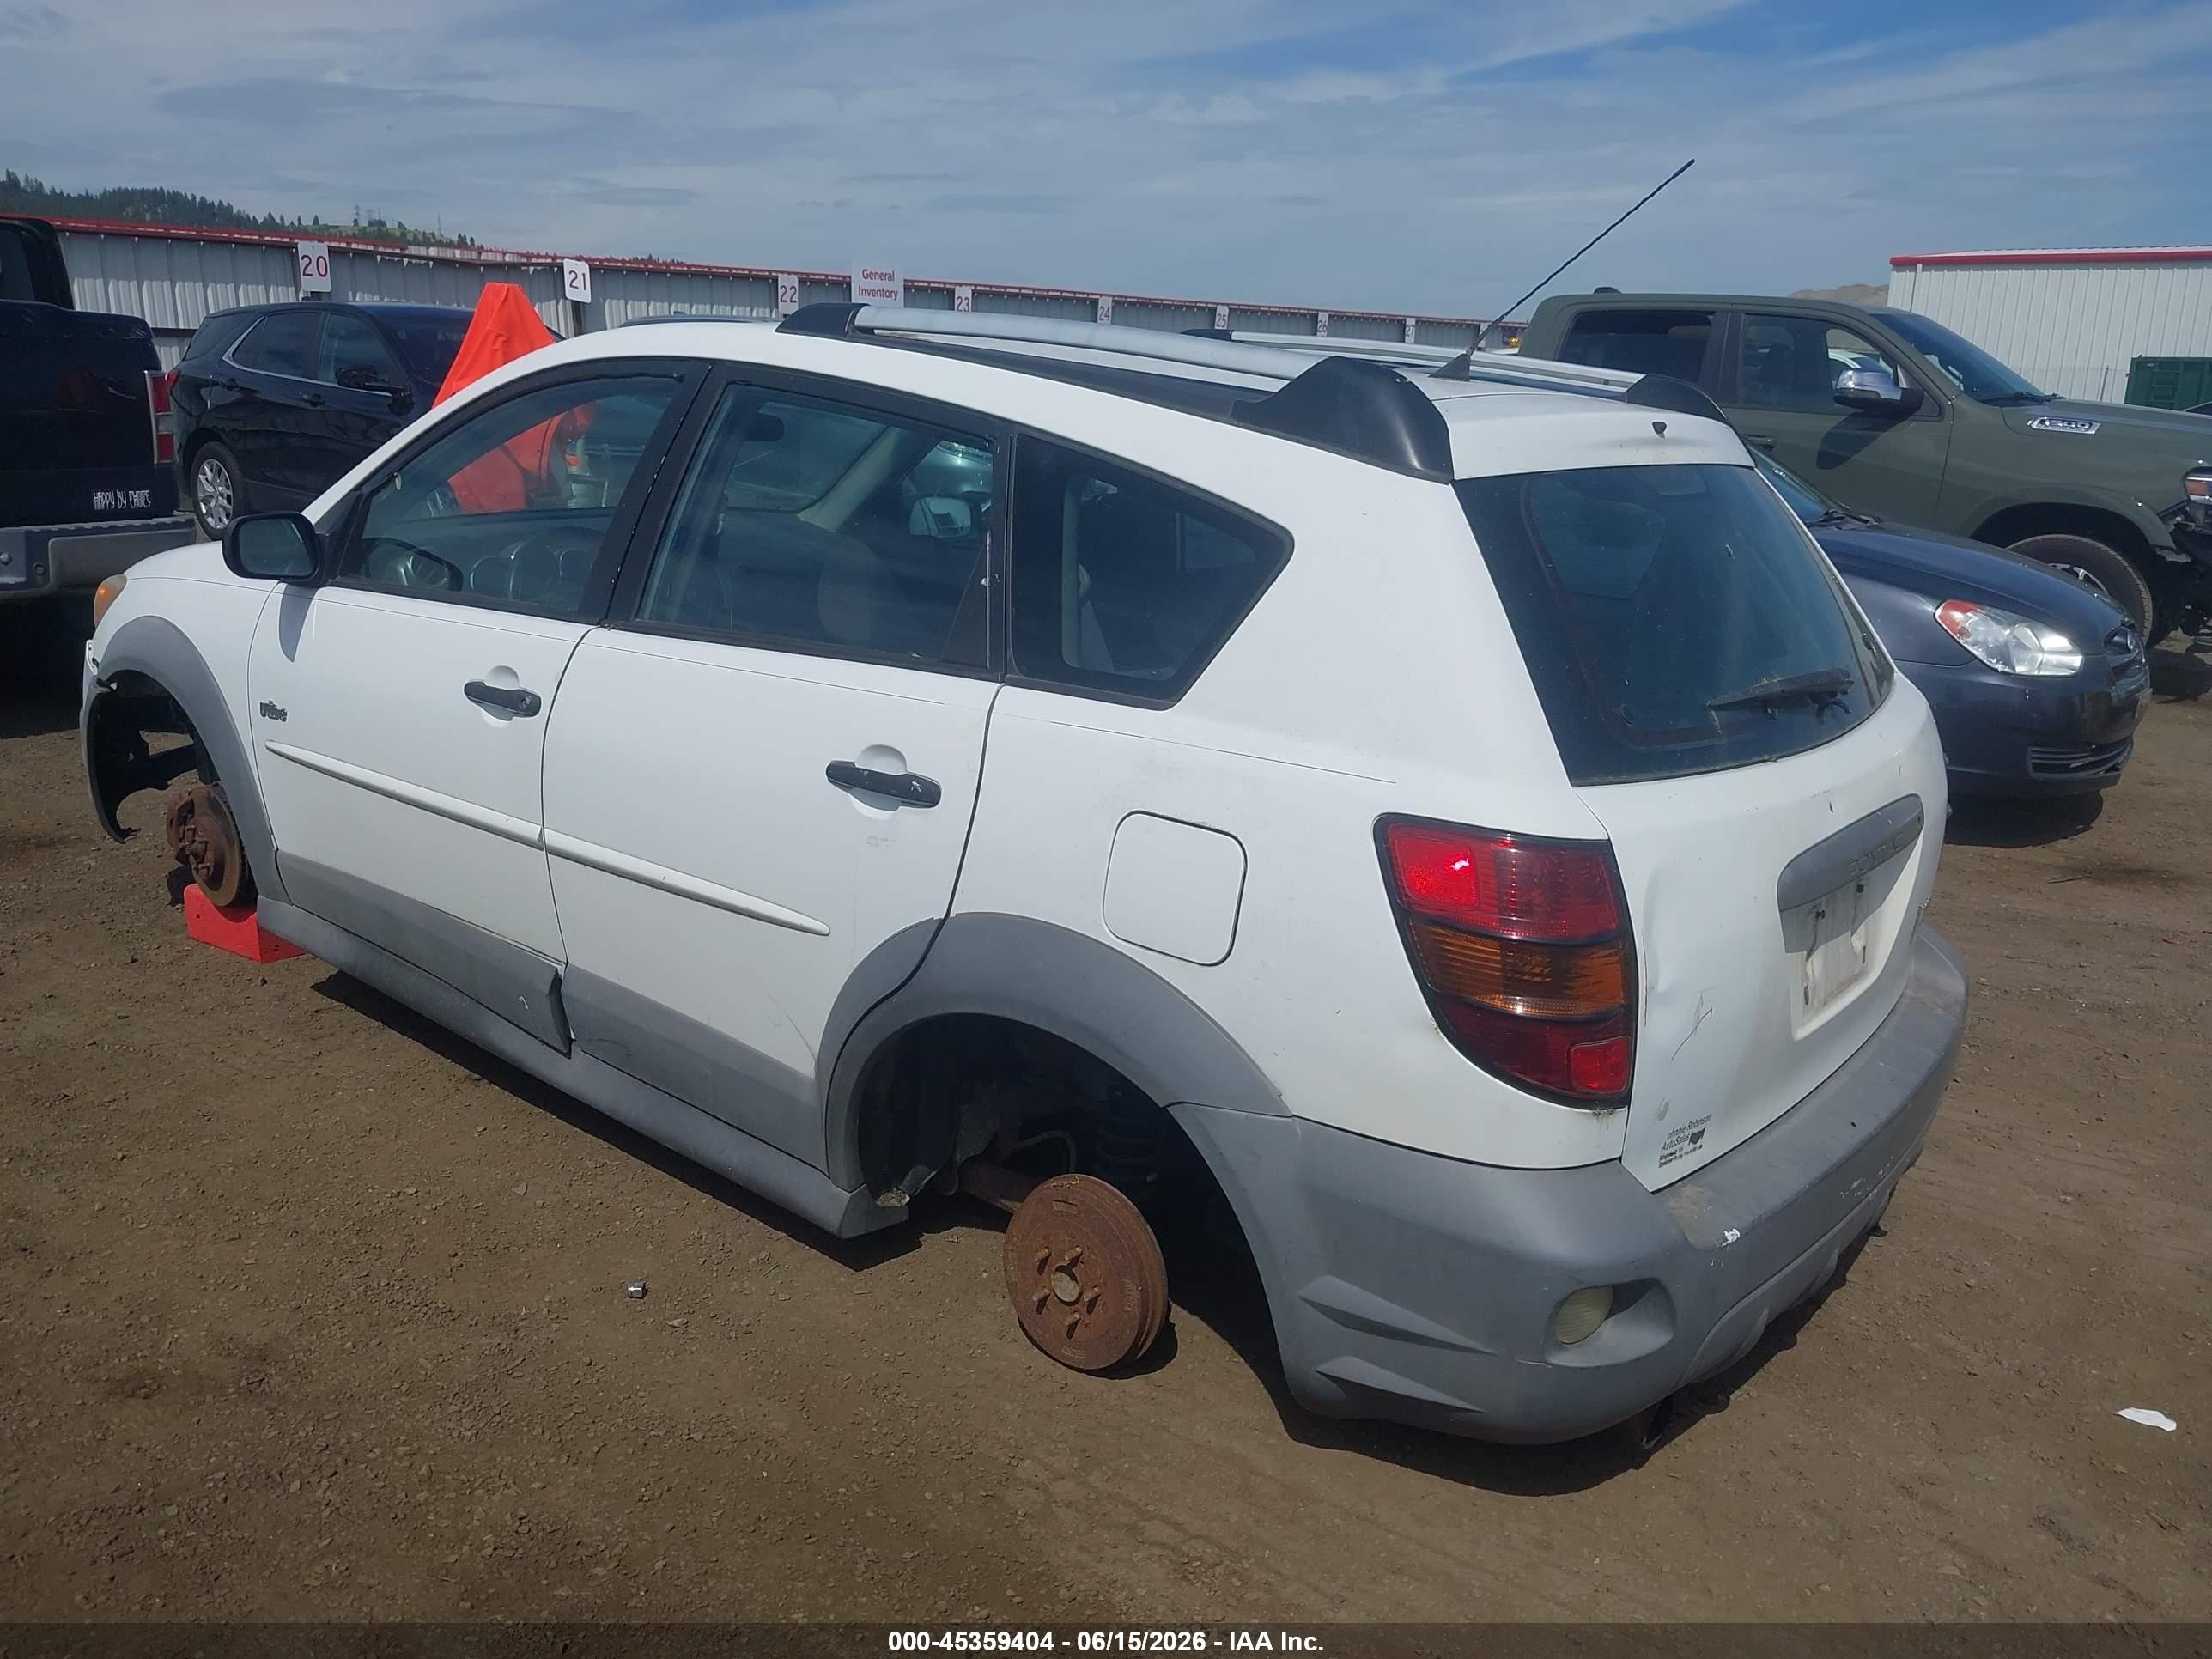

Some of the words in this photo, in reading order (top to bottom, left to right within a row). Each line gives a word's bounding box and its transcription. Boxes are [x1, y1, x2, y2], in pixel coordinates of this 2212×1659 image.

[301, 254, 328, 277] 20
[568, 270, 586, 291] 21
[861, 268, 895, 282] General
[780, 285, 798, 303] 22
[858, 284, 898, 301] Inventory
[956, 296, 970, 312] 23
[1099, 306, 1110, 321] 24
[1216, 313, 1227, 328] 25
